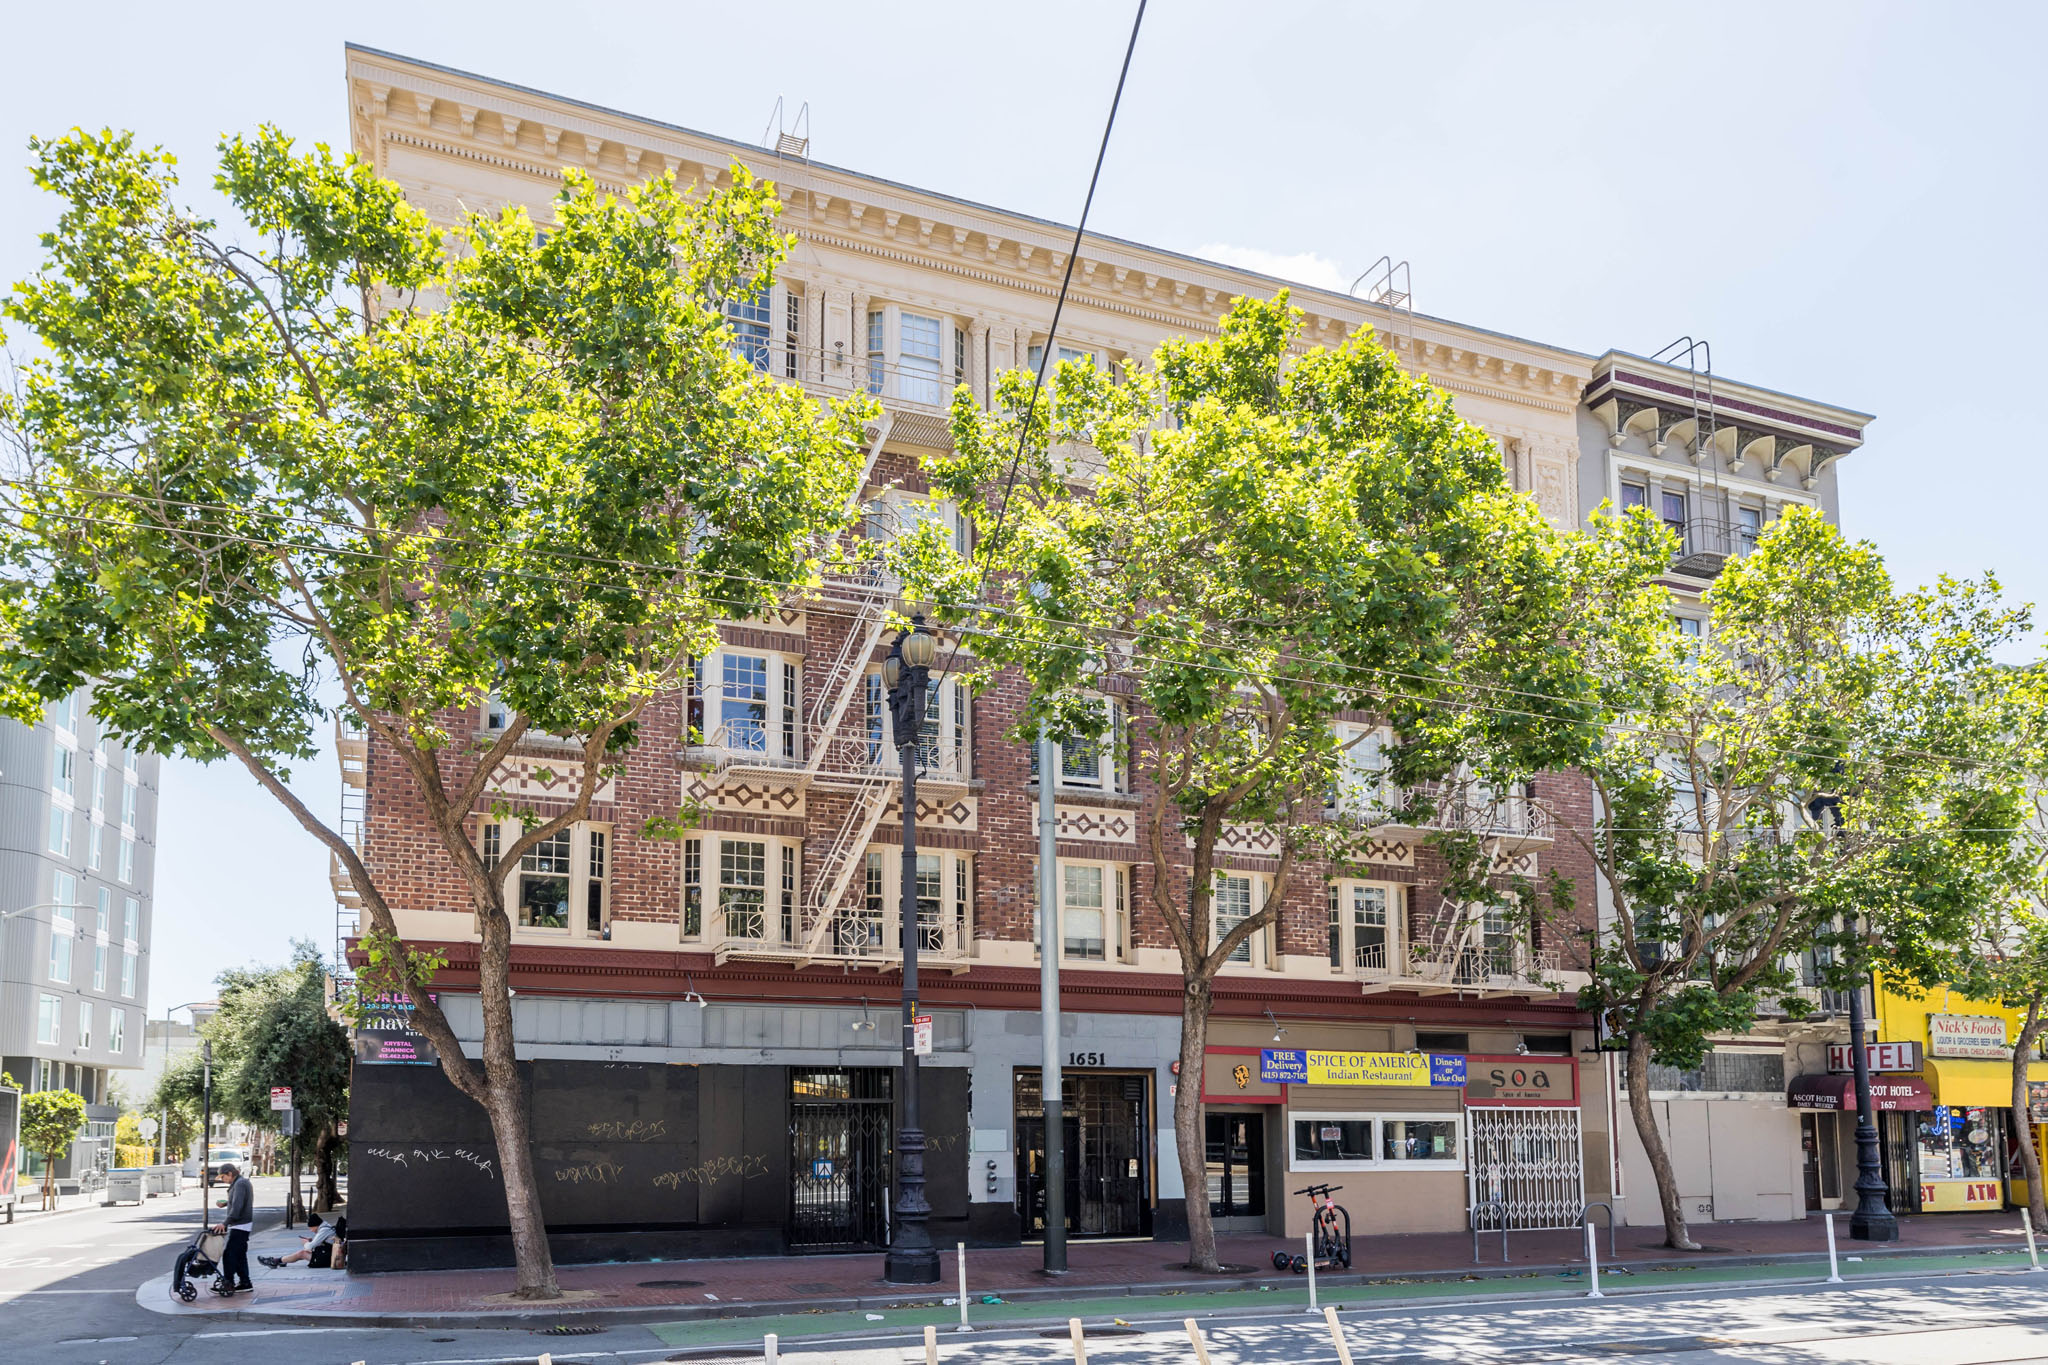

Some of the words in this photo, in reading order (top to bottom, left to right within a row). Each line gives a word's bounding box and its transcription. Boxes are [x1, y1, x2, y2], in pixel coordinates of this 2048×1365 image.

[1936, 1020, 1968, 1034] Nick's
[1971, 1021, 2002, 1035] Foods
[1069, 1052, 1105, 1066] 1651
[1273, 1051, 1296, 1061] FREE
[1309, 1054, 1346, 1067] SPICE
[1350, 1055, 1367, 1068] OF
[1369, 1056, 1428, 1069] AMERICA
[1435, 1057, 1462, 1067] Dine-In
[1267, 1060, 1303, 1072] Delivery
[1261, 1071, 1279, 1080] (415)
[1279, 1071, 1307, 1080] 872-7187
[1327, 1069, 1360, 1080] Indian
[1362, 1070, 1412, 1081] Restaurant
[1433, 1074, 1450, 1083] Take
[1451, 1074, 1466, 1083] Out
[1868, 1085, 1887, 1097] SCOT
[1890, 1085, 1914, 1097] HOTEL
[1793, 1094, 1815, 1102] ASCOT
[1816, 1095, 1838, 1103] HOTEL
[1880, 1101, 1897, 1109] 1657
[1921, 1185, 1935, 1202] BT
[1966, 1184, 1997, 1202] ATM
